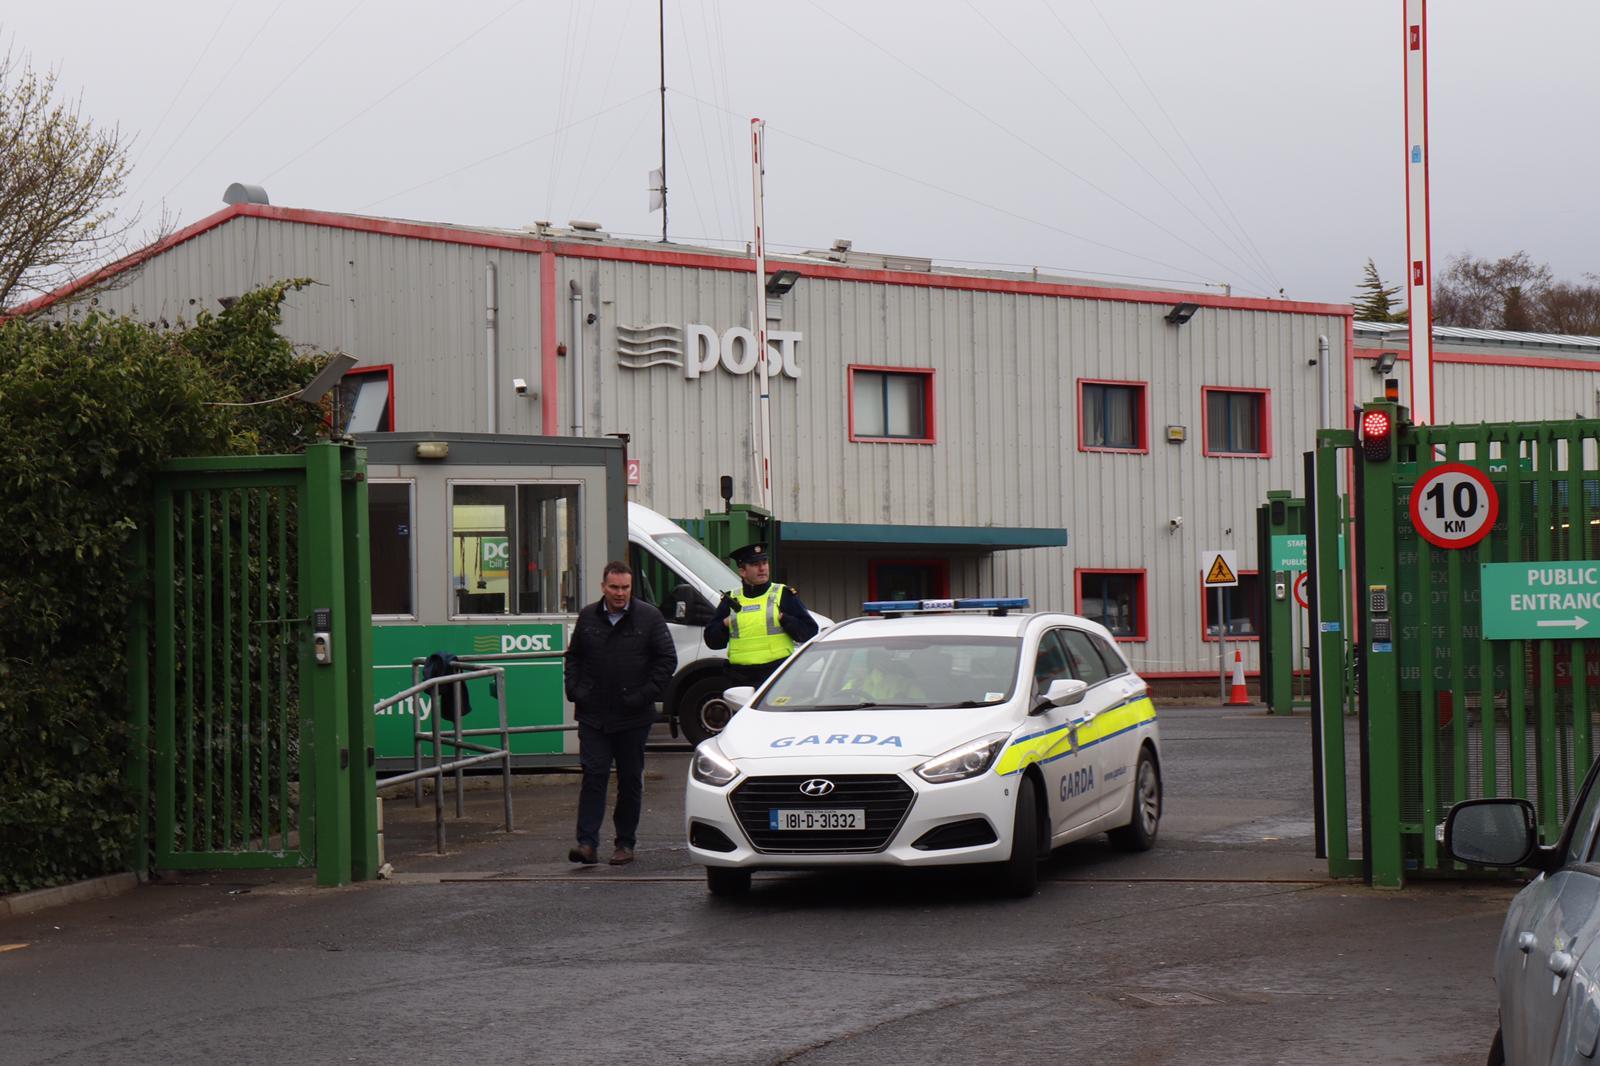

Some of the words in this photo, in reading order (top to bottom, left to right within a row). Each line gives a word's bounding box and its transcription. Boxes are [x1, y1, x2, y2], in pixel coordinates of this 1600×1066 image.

[685, 323, 803, 379] post
[629, 464, 637, 480] 2
[1426, 481, 1478, 519] 10
[1444, 520, 1466, 533] KM
[484, 542, 509, 561] po
[1527, 568, 1598, 586] PUBLIC
[1510, 592, 1600, 611] ENTRANC
[501, 634, 552, 653] post
[770, 734, 903, 748] GARDA
[1059, 765, 1095, 802] GARDA
[785, 813, 856, 829] 181-D-31332
